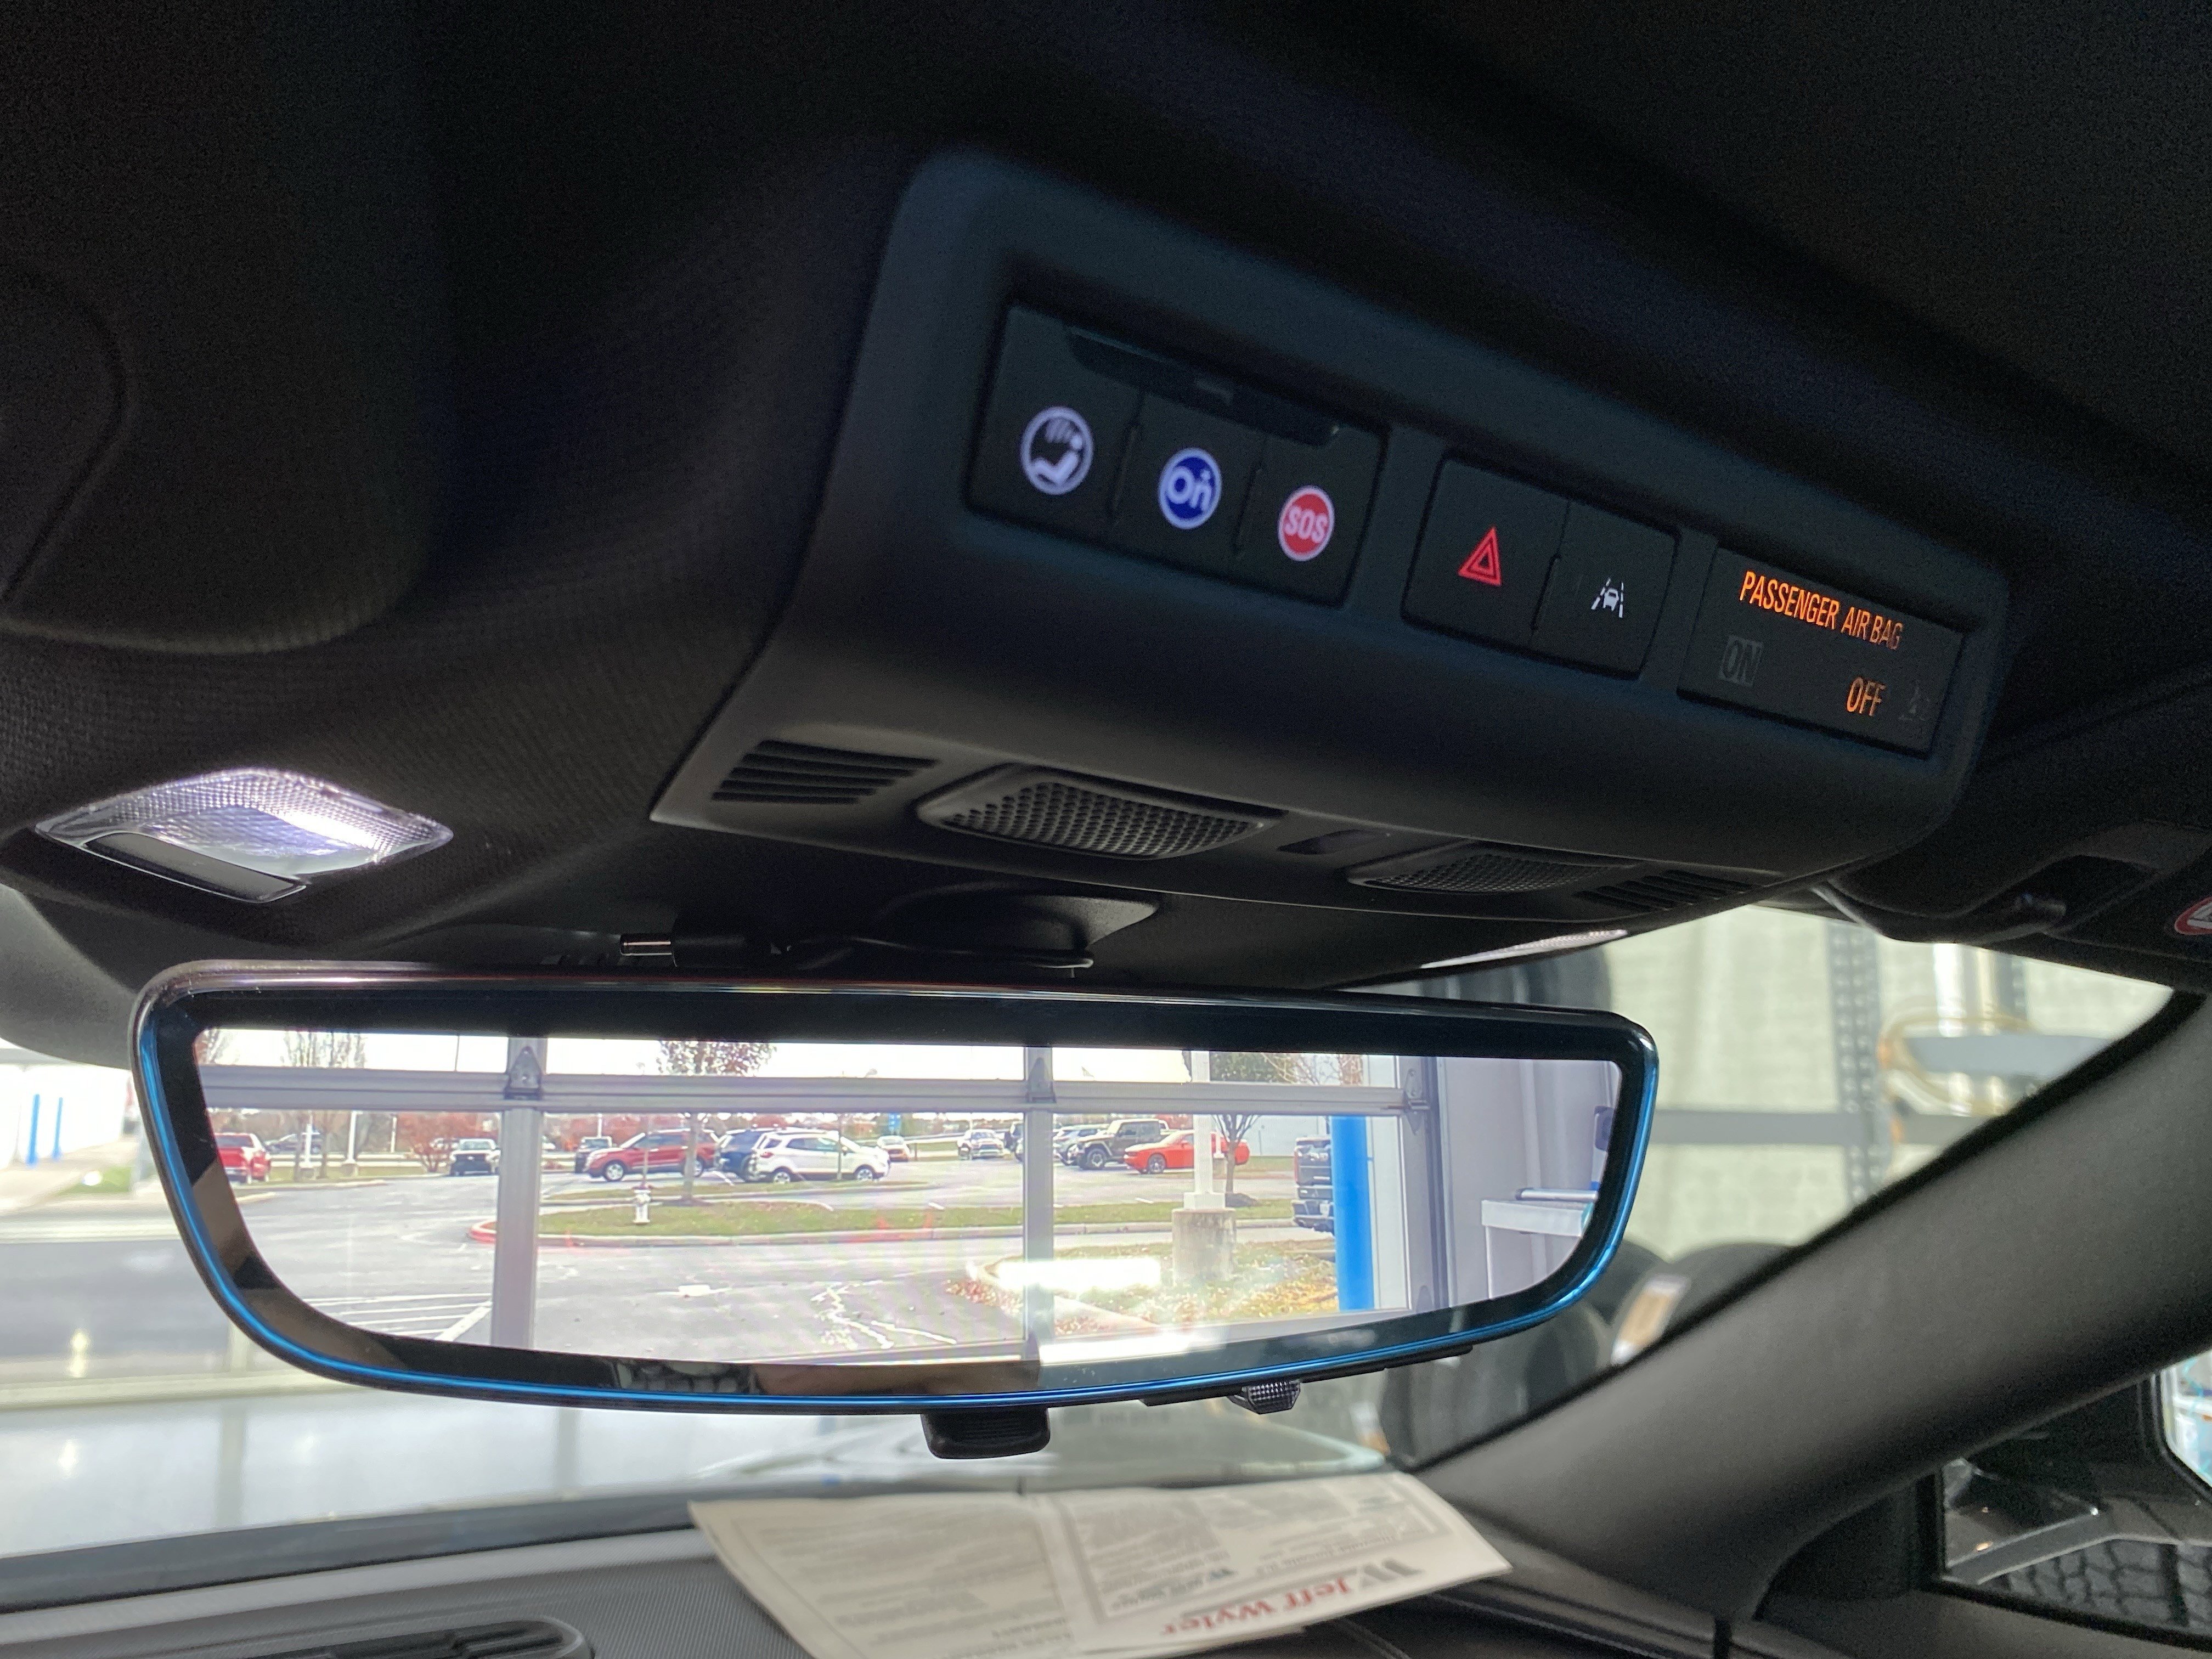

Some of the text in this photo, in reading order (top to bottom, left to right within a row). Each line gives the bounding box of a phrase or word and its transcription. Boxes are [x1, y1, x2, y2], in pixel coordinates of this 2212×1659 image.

[1285, 505, 1328, 544] SOS
[1739, 570, 1841, 630] PASSENGER
[1720, 639, 1763, 686] ON
[1846, 676, 1887, 717] OFF
[1283, 1577, 1352, 1611] Jeff
[1161, 1599, 1277, 1635] Wyler
